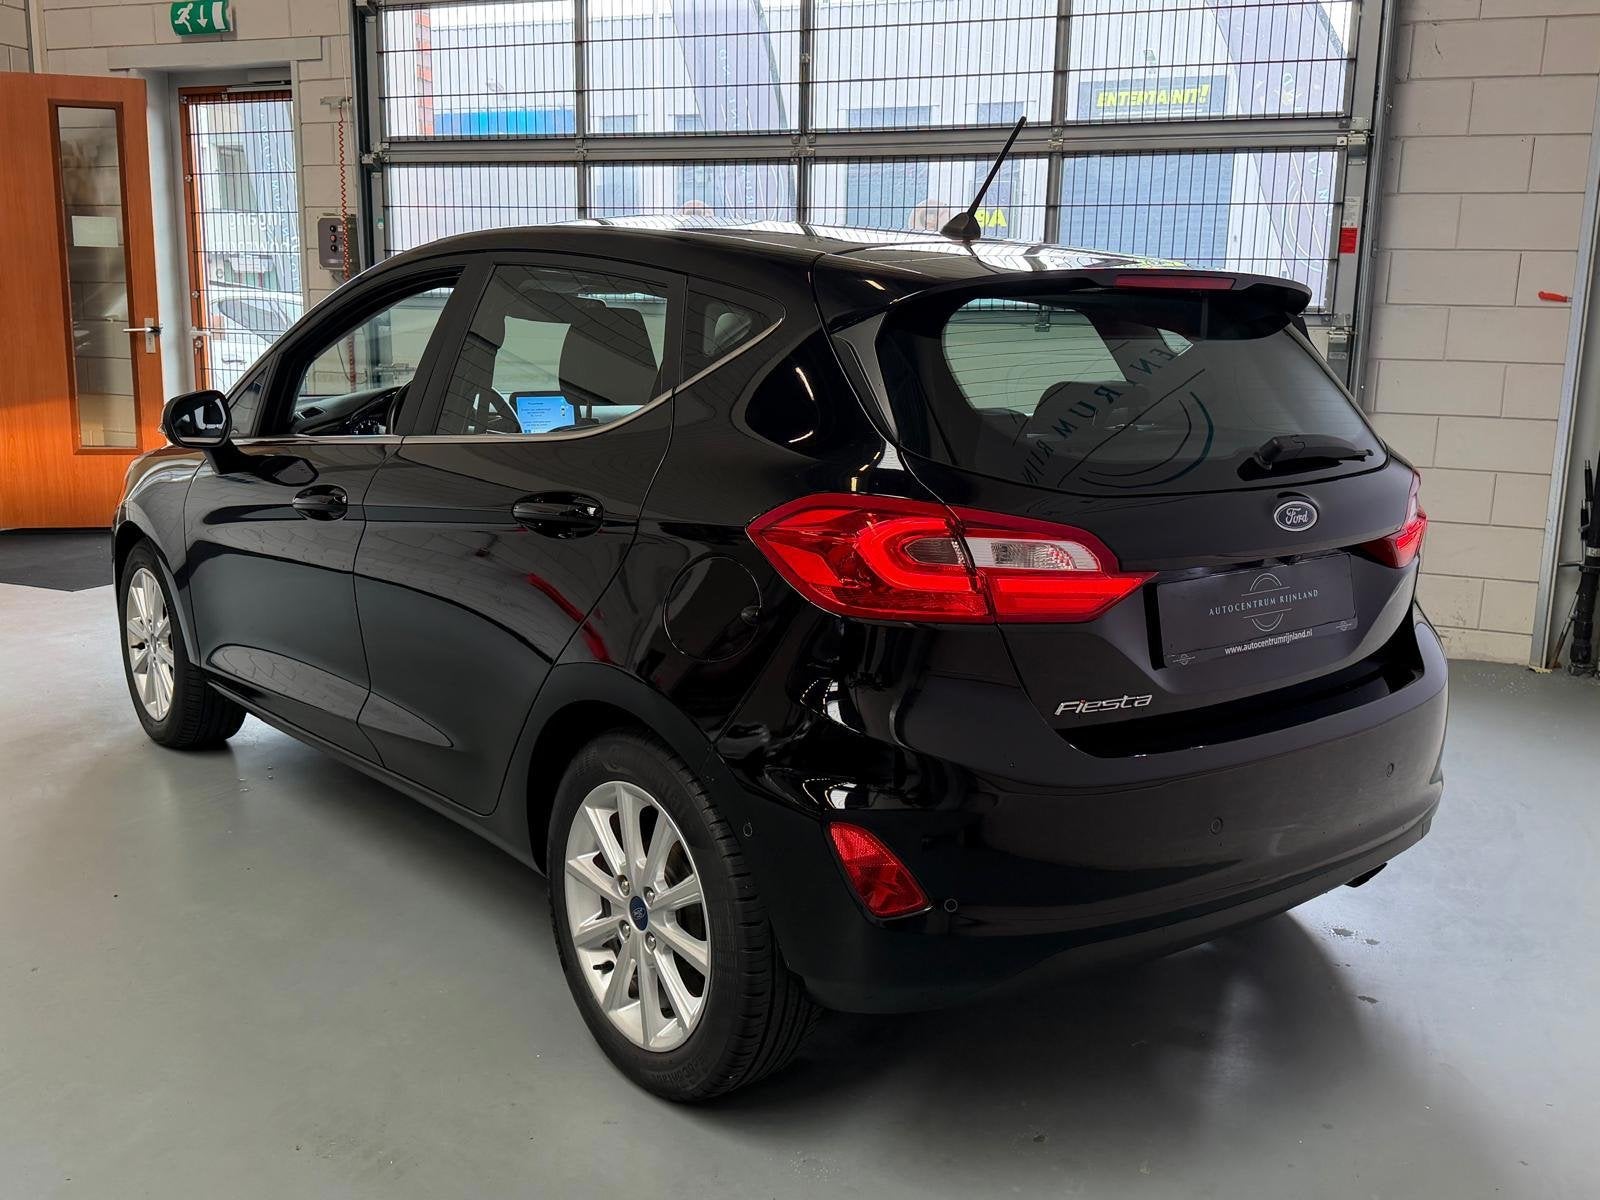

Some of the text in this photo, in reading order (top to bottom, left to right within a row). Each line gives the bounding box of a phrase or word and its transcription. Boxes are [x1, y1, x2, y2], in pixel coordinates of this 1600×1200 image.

[1097, 84, 1209, 107] ENTERTANIT!
[1285, 507, 1308, 525] Ford
[1209, 589, 1319, 616] AUTOCENTRUM RIJNLAND
[1225, 628, 1313, 655] www.autocentrumrijnland.nl
[1054, 694, 1153, 716] Fiesta
